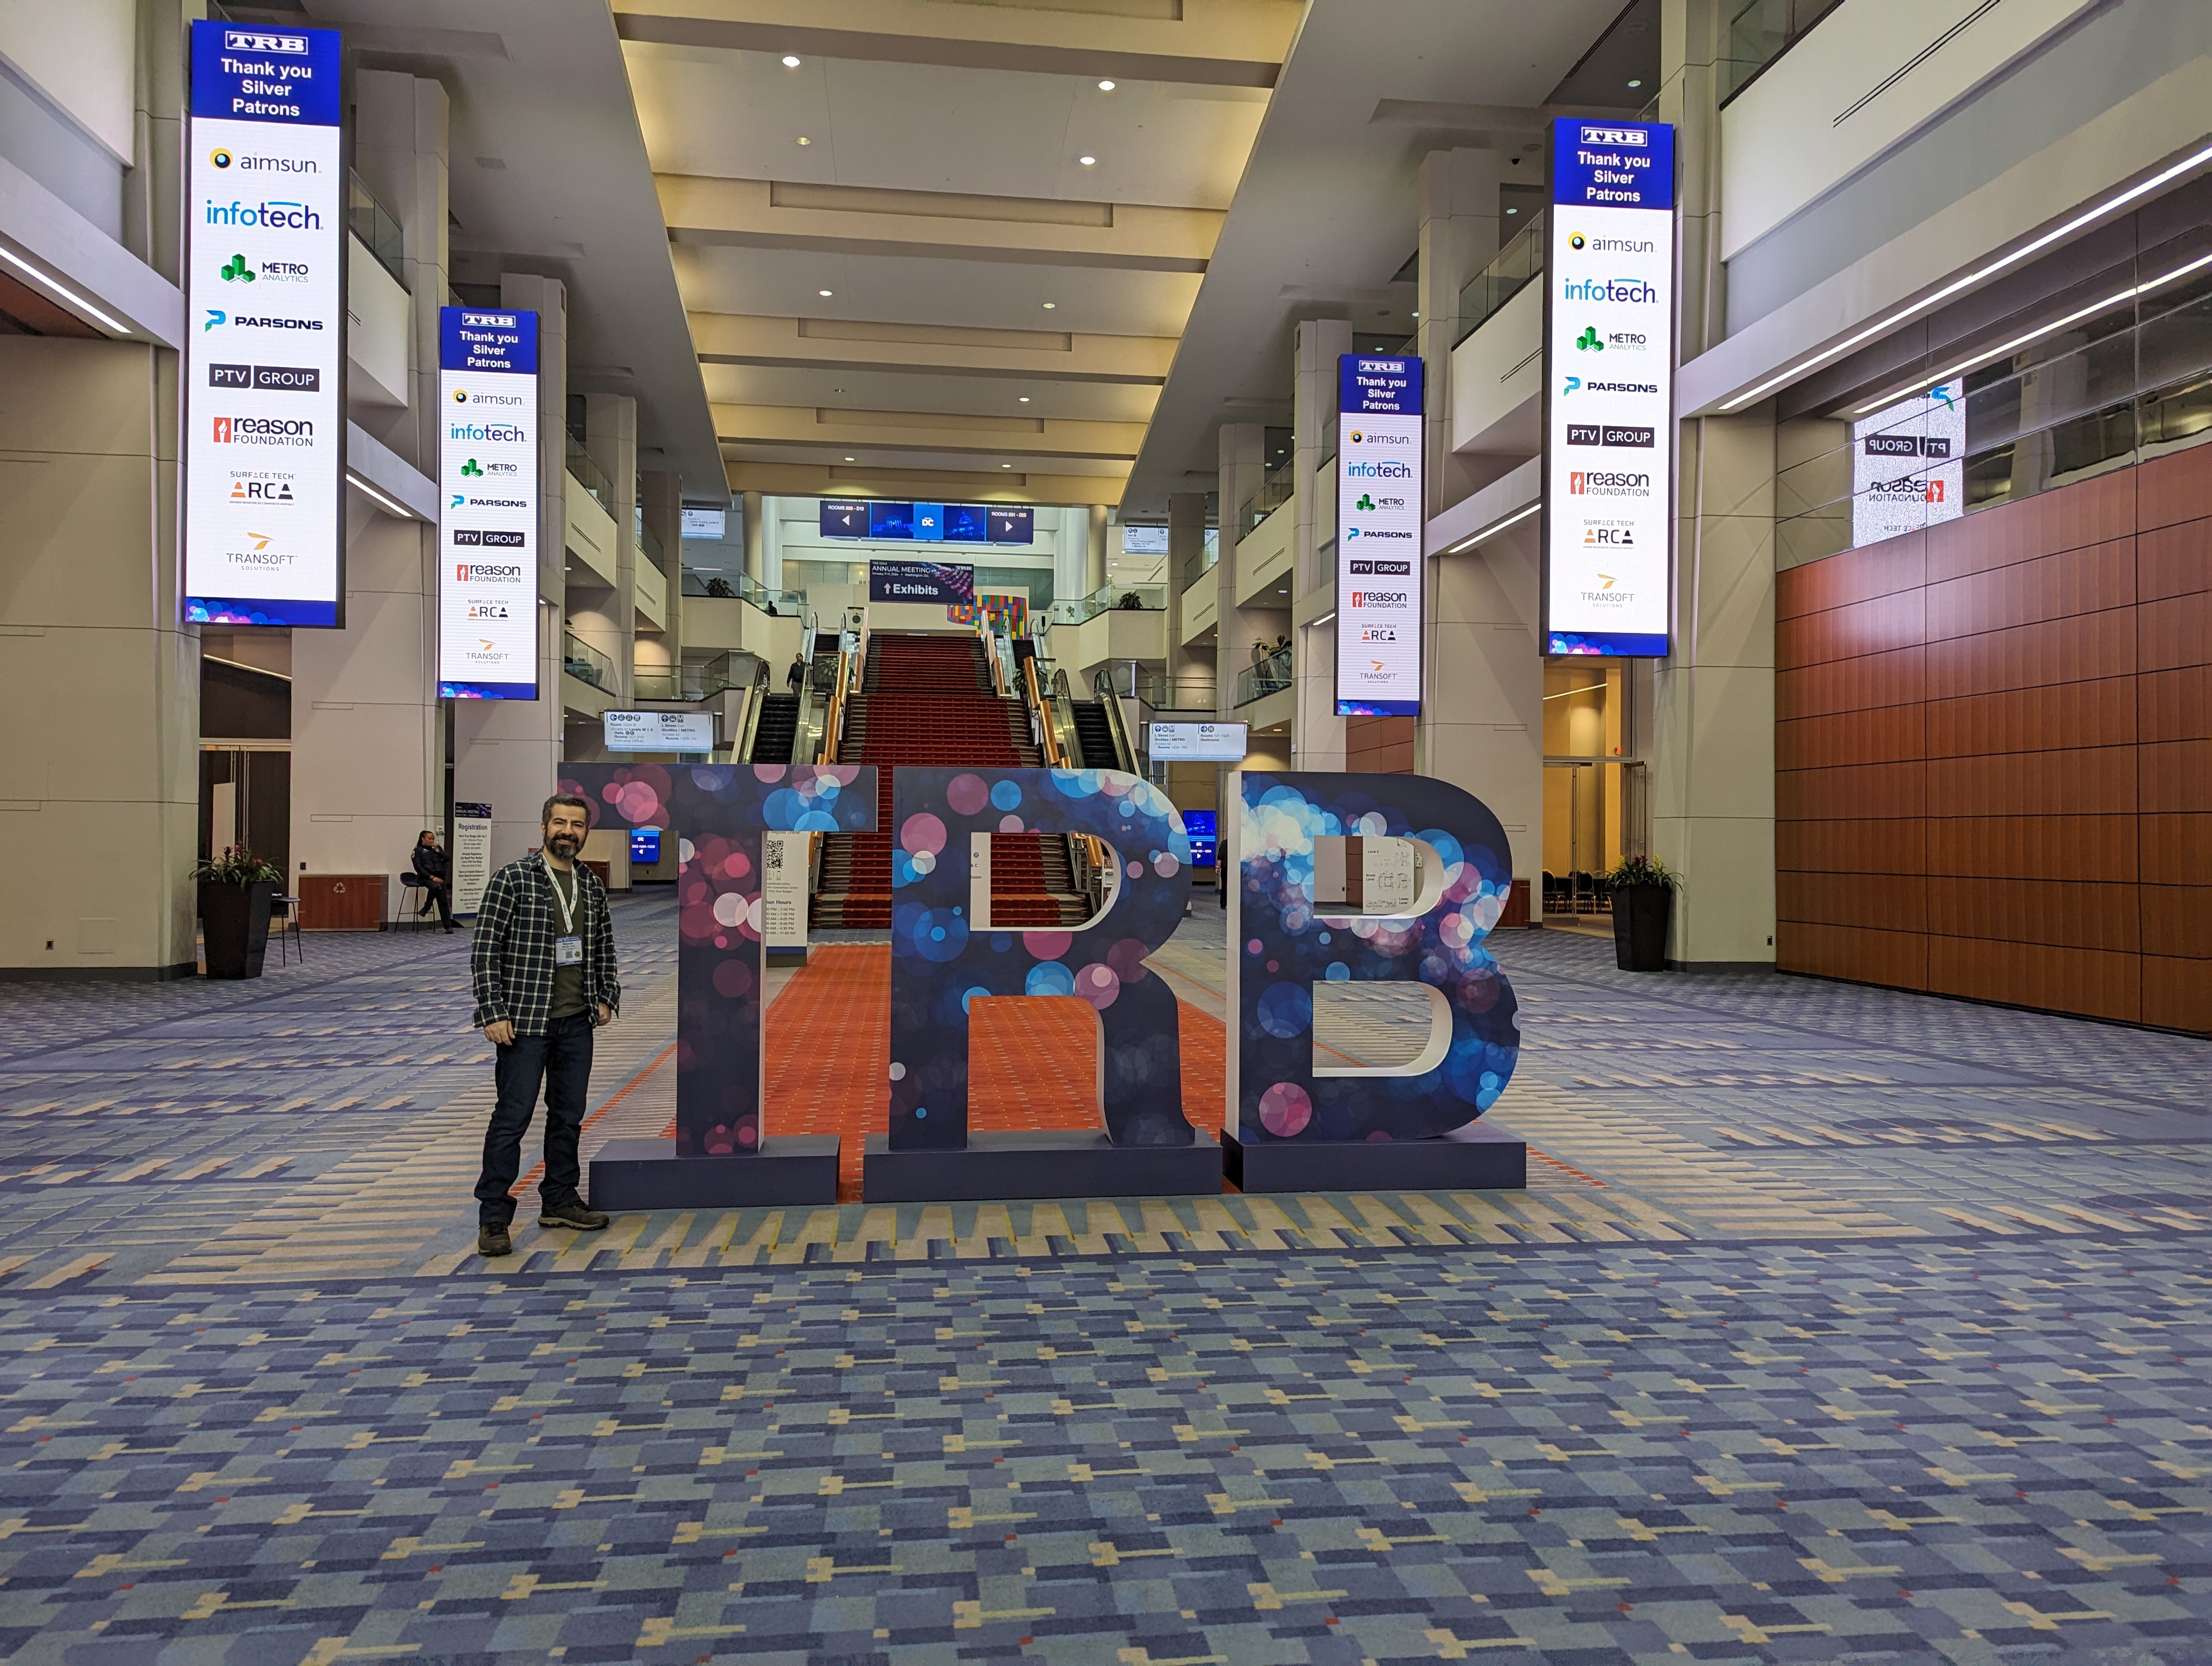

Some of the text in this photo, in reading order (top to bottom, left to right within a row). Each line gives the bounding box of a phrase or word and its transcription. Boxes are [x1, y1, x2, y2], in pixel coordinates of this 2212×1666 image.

[229, 34, 304, 52] TRB
[221, 57, 312, 80] Thank you
[242, 80, 292, 96] Silver
[233, 98, 300, 117] Patrons
[1585, 129, 1644, 144] TRB
[1577, 151, 1650, 170] Thank you
[1594, 170, 1635, 184] Silver
[1586, 187, 1641, 202] Patrons
[262, 262, 308, 275] METRO
[262, 274, 308, 283] ANALYTICS
[235, 316, 323, 330] PARSONS
[465, 315, 513, 326] TRB
[460, 331, 518, 344] Thank you
[1609, 333, 1646, 344] METRO
[473, 344, 505, 355] Silver
[467, 357, 511, 368] Patrons
[1361, 362, 1403, 371] TRB
[215, 369, 314, 386] PTV GROUP
[1356, 376, 1406, 388] Thank you
[1587, 382, 1657, 393] PARSONS
[1368, 388, 1396, 399] Silver
[1363, 400, 1400, 411] Patrons
[234, 417, 313, 436] reason
[234, 435, 313, 446] FOUNDATION
[1571, 430, 1650, 443] PTV GROUP
[487, 463, 517, 472] METRO
[1587, 472, 1649, 487] reason
[231, 482, 293, 499] ARCA
[1587, 488, 1649, 497] FOUNDATION
[470, 498, 526, 507] PARSONS
[922, 518, 934, 527] DC
[457, 533, 522, 543] PTV GROUP
[1584, 529, 1634, 544] ARCA
[226, 553, 294, 565] TRANSOFT
[470, 565, 520, 576] reason
[1377, 564, 1408, 572] GROUP
[893, 584, 939, 595] Exhibits
[1364, 592, 1406, 602] reason
[1581, 592, 1635, 602] TRANSOFT
[468, 606, 508, 618] ARCA
[1362, 630, 1396, 640] ARCA
[458, 823, 488, 831] Registration
[557, 762, 1521, 1159] TRB
